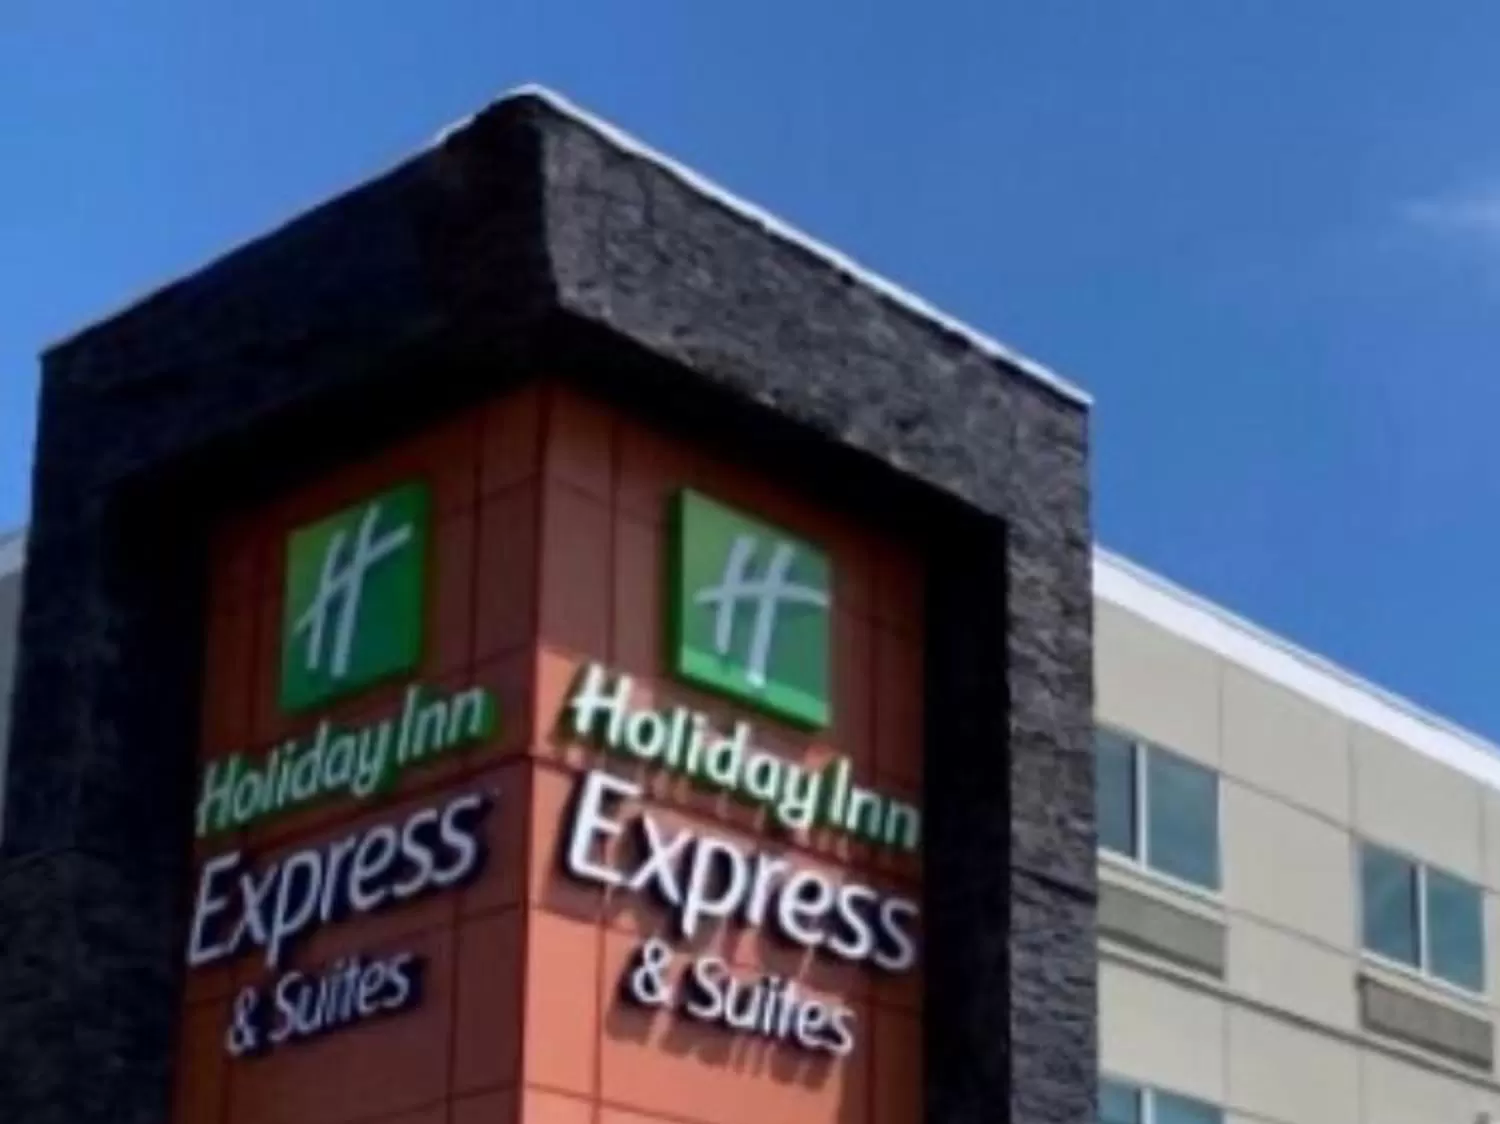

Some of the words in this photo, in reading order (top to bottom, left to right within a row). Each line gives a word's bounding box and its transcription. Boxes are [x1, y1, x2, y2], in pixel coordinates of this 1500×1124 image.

[294, 502, 412, 679] H
[693, 534, 831, 688] H
[196, 716, 391, 835] Holiday
[397, 684, 485, 767] Inn
[571, 663, 822, 828] Holiday
[829, 758, 922, 848] Inn
[187, 794, 483, 967] Express
[567, 767, 917, 971] Express
[226, 986, 257, 1056] &
[268, 952, 413, 1044] Suites
[631, 936, 673, 1005] &
[687, 957, 855, 1056] Suites
